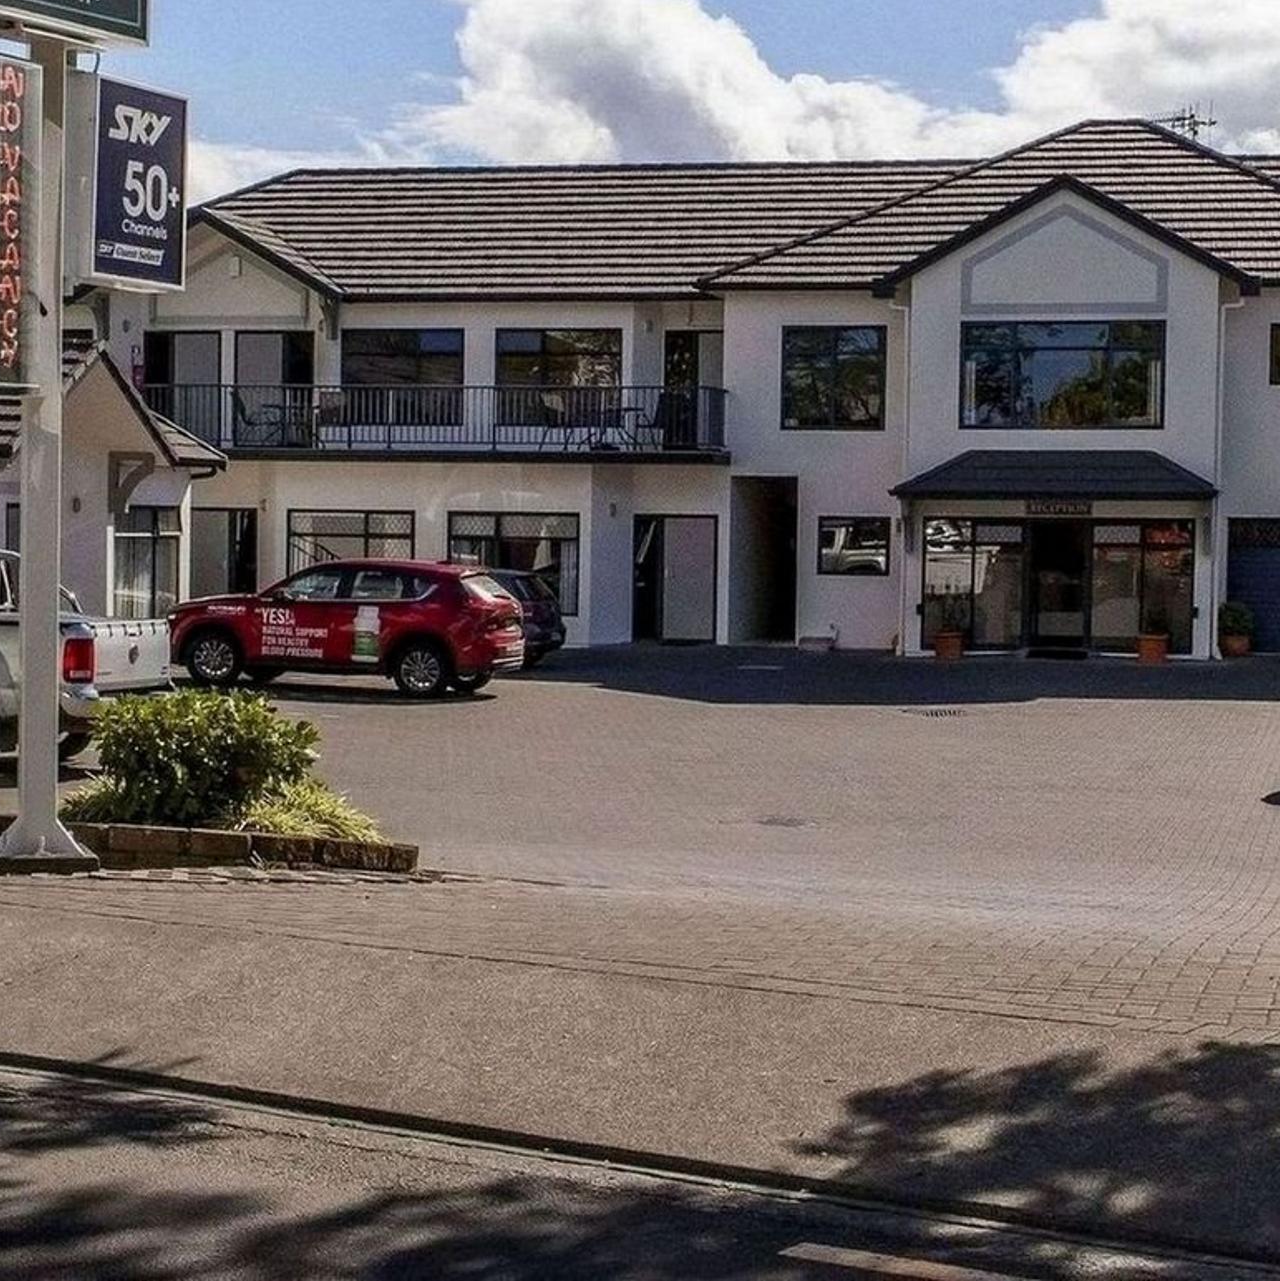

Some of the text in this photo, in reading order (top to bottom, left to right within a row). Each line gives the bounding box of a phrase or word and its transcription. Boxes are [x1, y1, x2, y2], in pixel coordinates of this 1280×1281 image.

[107, 103, 173, 147] SKY
[121, 218, 168, 241] Channels
[1030, 501, 1089, 513] RECEPTION
[295, 627, 329, 638] SUPPORT
